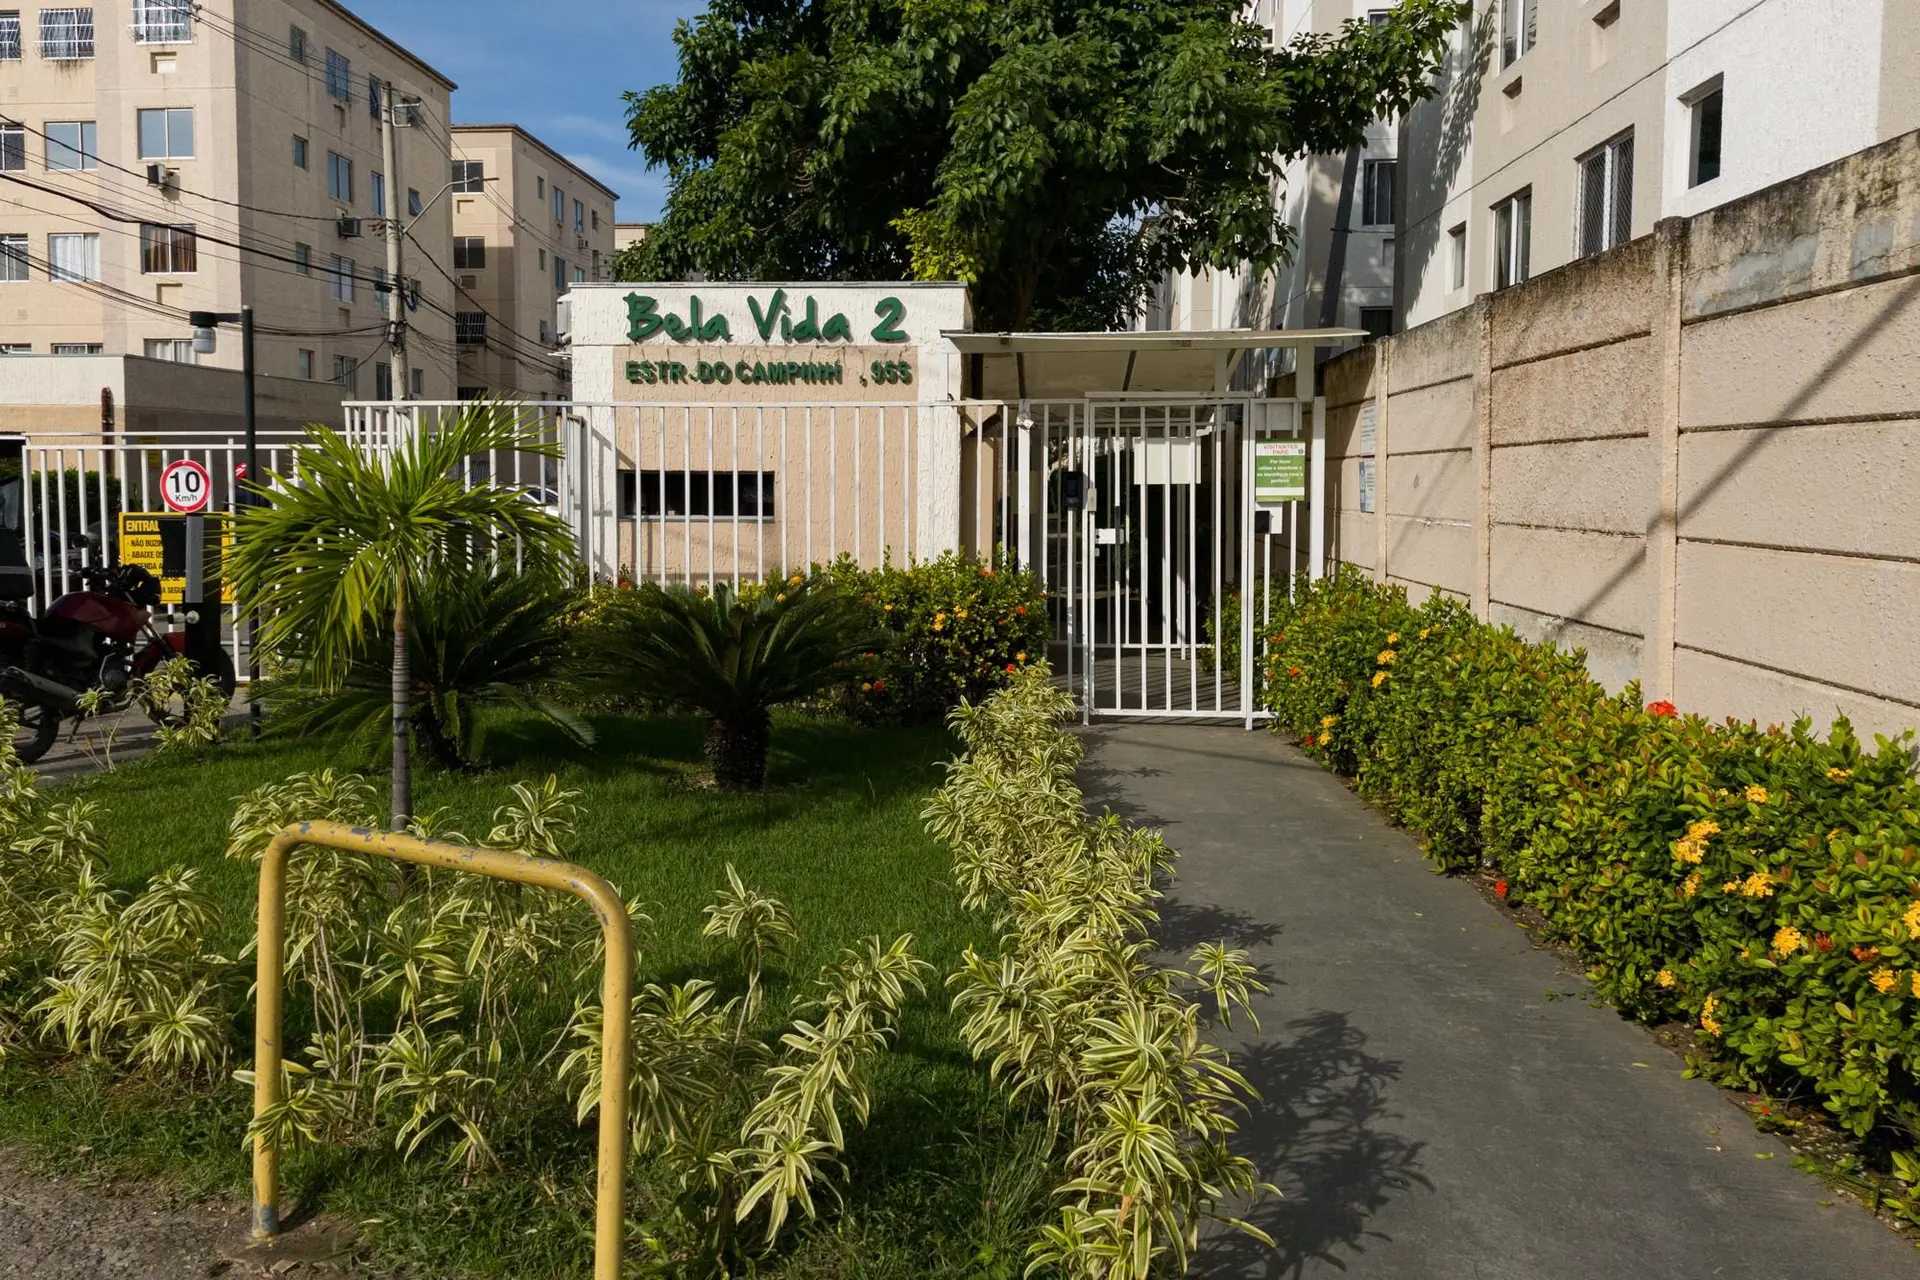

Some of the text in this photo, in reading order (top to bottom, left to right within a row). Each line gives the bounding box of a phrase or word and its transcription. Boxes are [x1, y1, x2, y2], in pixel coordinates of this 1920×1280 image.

[622, 286, 908, 343] Bela Vida 2
[169, 471, 200, 493] 10
[175, 494, 198, 502] Km/h
[132, 551, 154, 559] ABAIXE
